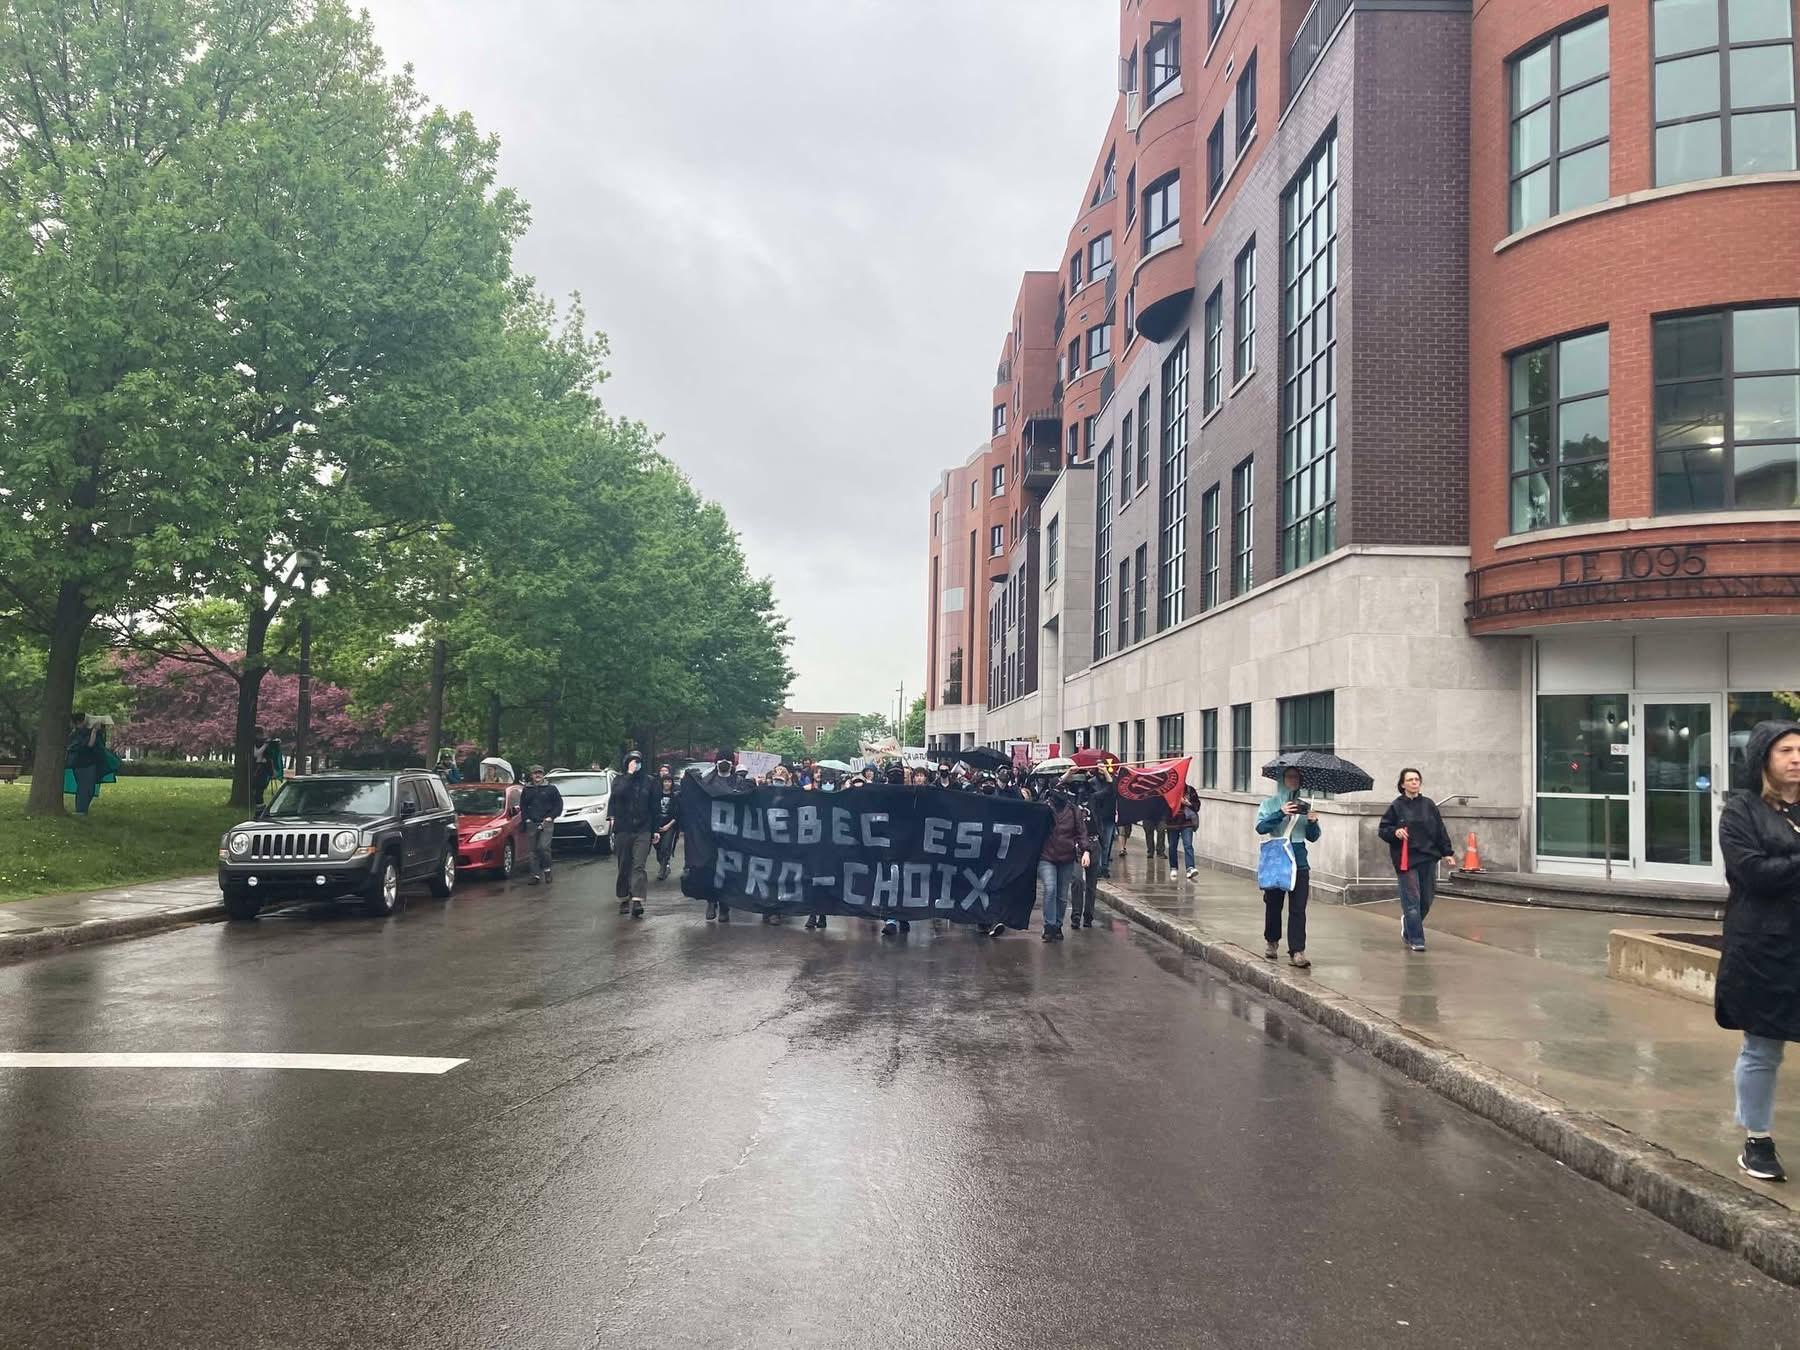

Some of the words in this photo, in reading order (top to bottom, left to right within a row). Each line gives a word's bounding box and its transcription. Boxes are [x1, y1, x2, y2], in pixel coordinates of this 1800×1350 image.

[1559, 552, 1602, 586] LE
[1616, 546, 1707, 580] 1095
[924, 817, 1023, 859] EST
[714, 849, 993, 911] PRO-CHOIX
